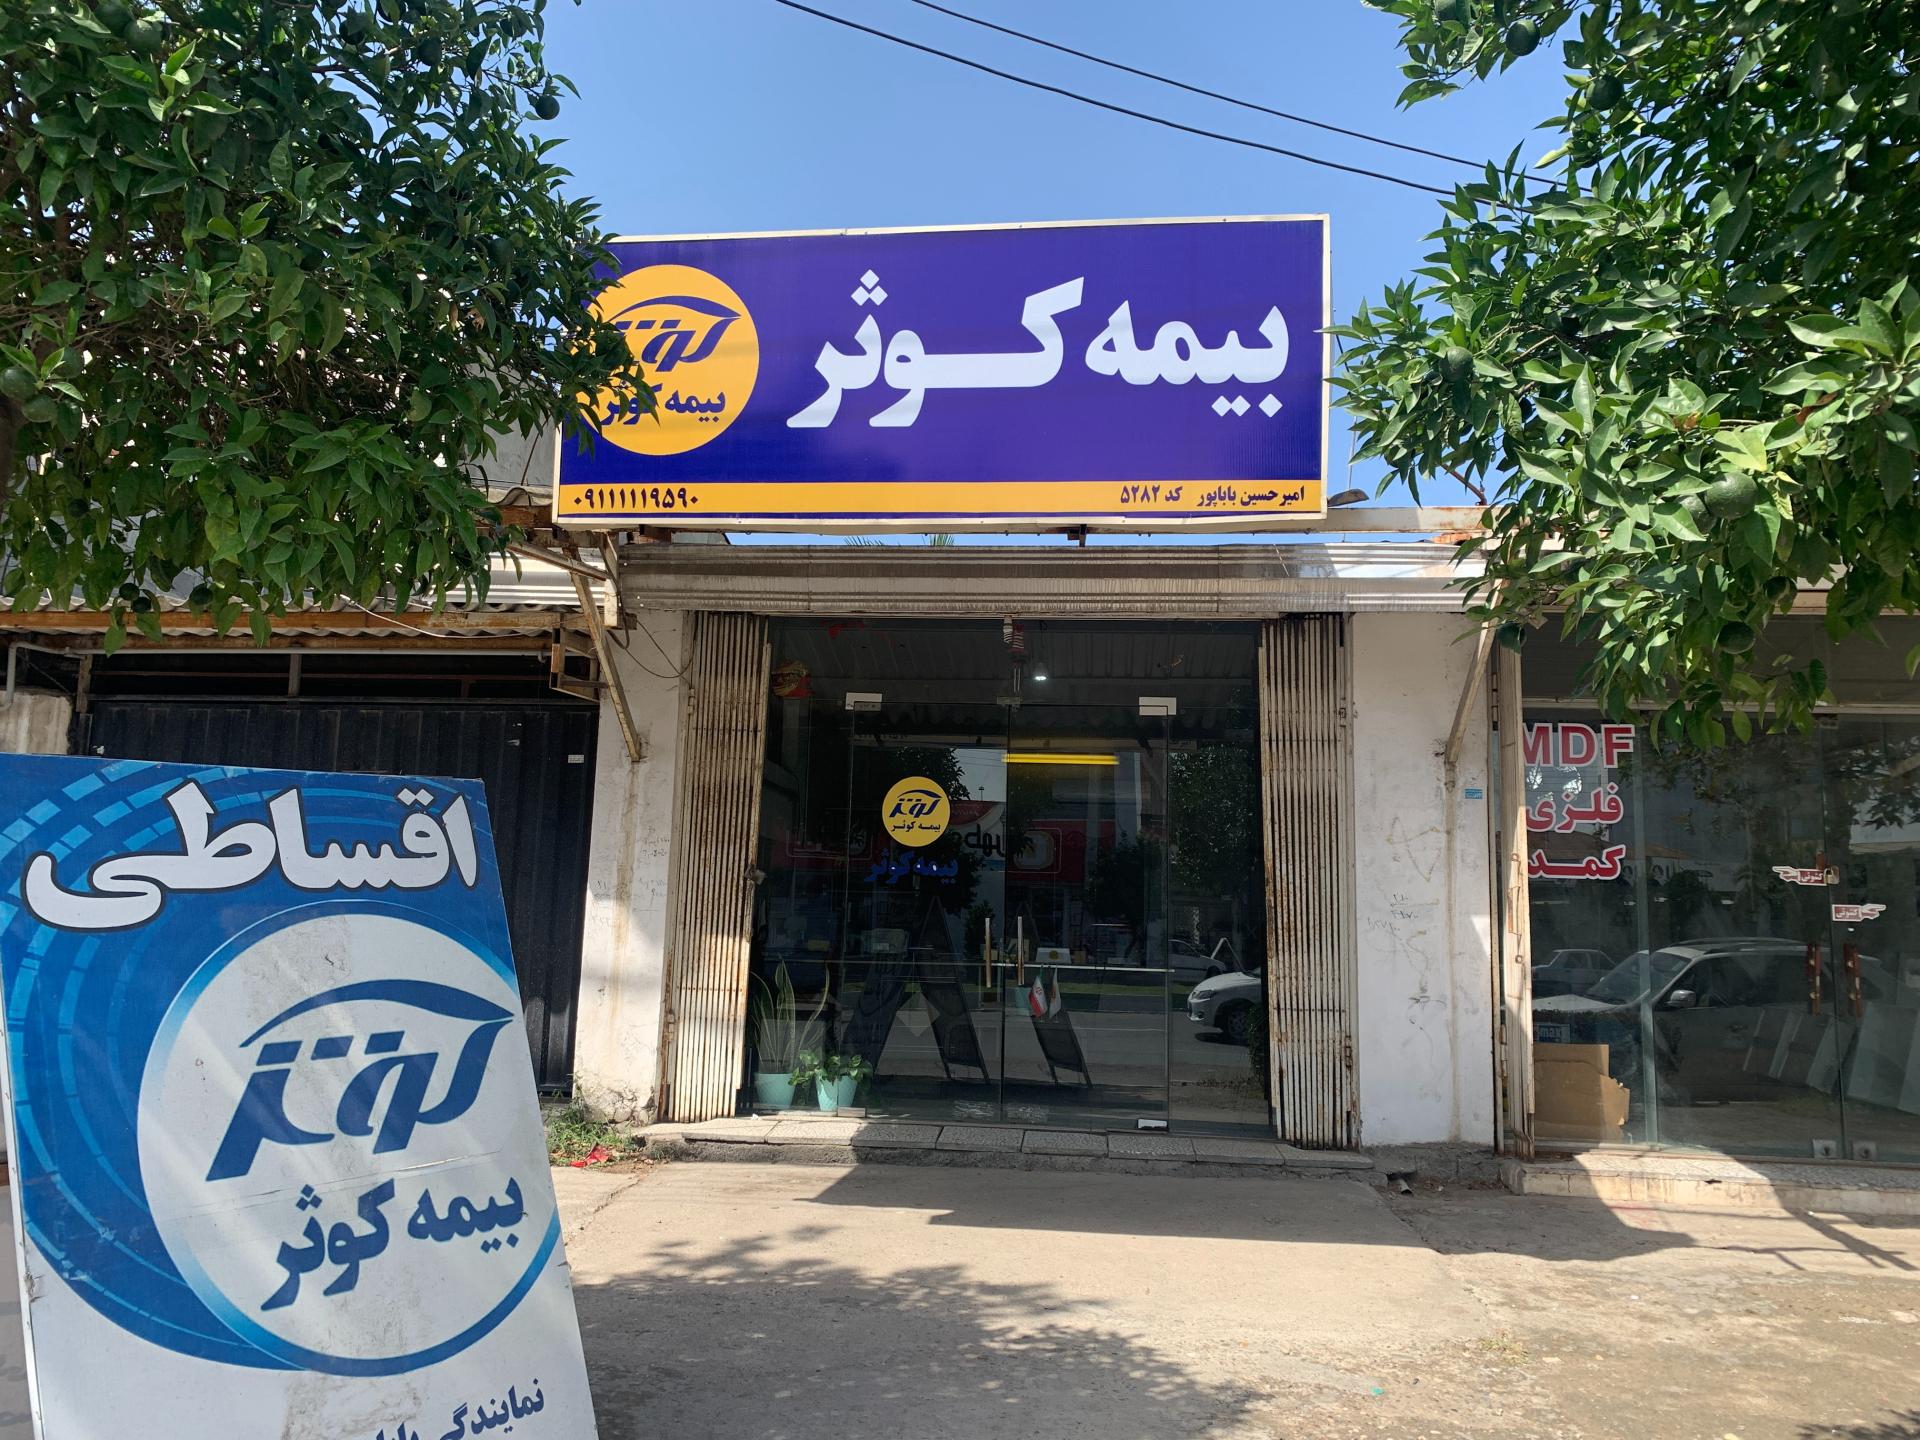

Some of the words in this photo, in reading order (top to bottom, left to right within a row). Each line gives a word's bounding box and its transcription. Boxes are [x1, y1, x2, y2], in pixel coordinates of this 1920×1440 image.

[786, 269, 1084, 428] کوثر
[1085, 300, 1290, 418] بیمه
[664, 389, 726, 423] بیمه
[574, 487, 699, 509] ۰۹۱۱۱۱۱۹۵۹۰
[1120, 485, 1161, 504] ۵۲۸۲
[1164, 485, 1184, 502] کد
[1523, 723, 1635, 768] MDF
[1526, 782, 1623, 833] فلزی
[891, 820, 916, 833] کوثر
[917, 823, 941, 833] بیمه
[24, 782, 480, 931] اقساطی
[864, 847, 914, 884] کوثر
[912, 855, 959, 884] بیمه
[1528, 844, 1627, 880] کمد
[407, 1176, 525, 1254] بیمه
[260, 1178, 395, 1311] کوثر
